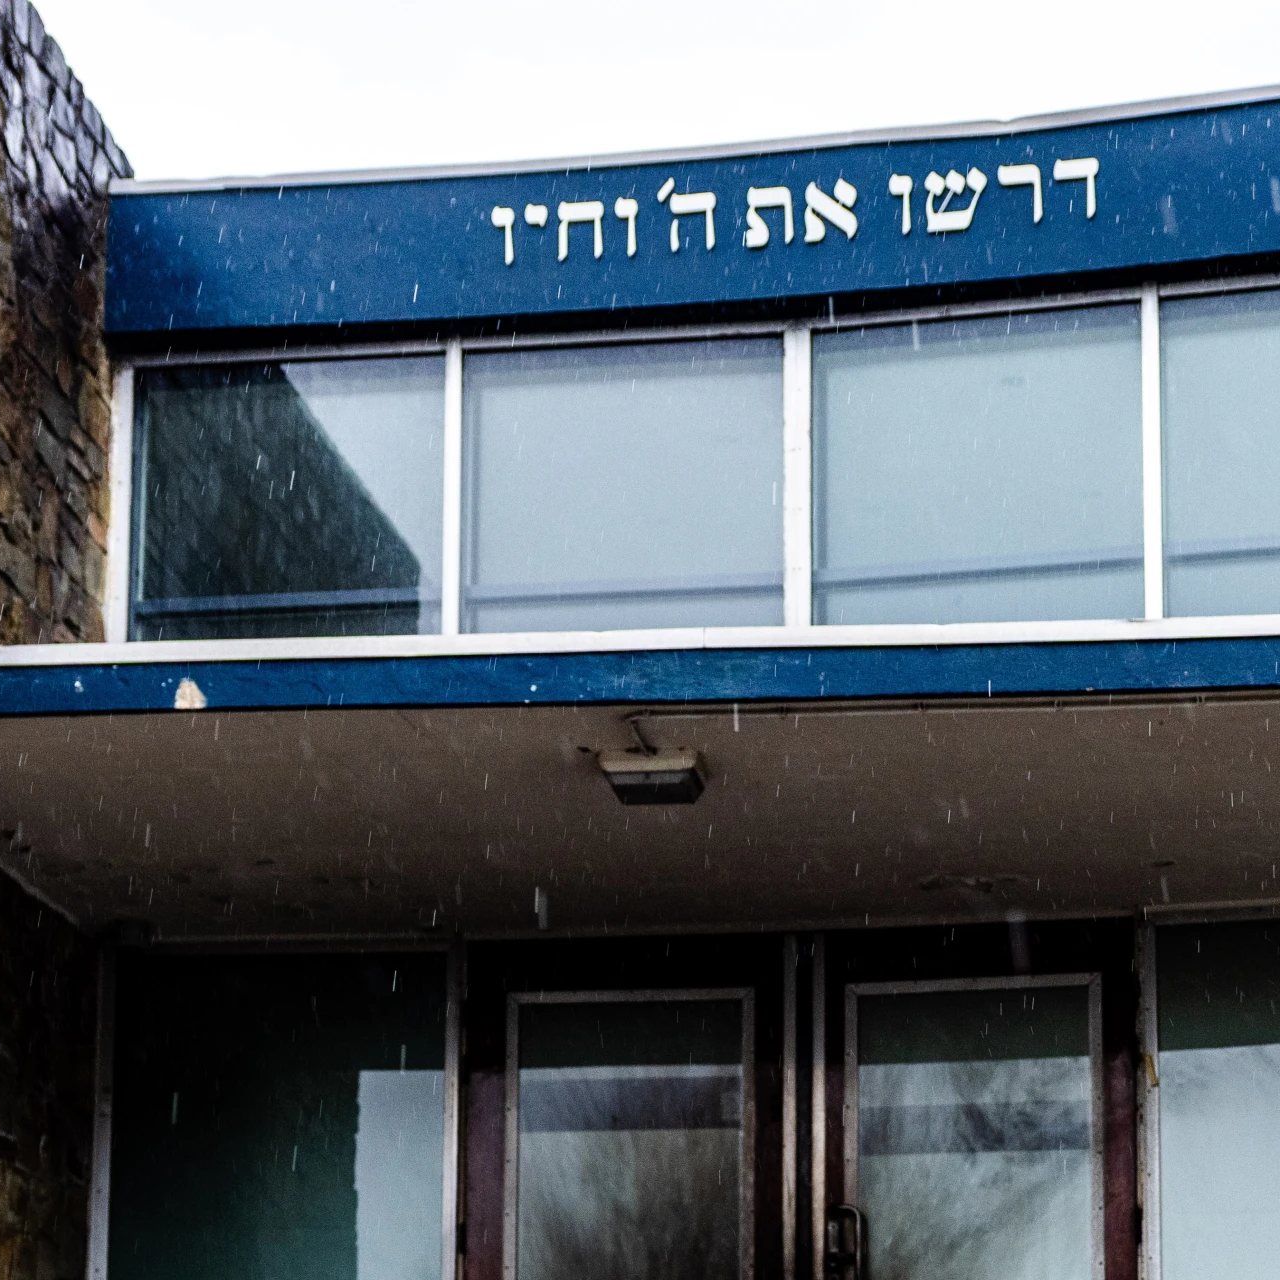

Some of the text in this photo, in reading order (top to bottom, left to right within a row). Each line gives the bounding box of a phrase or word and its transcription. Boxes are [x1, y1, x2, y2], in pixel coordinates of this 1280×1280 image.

[490, 196, 640, 266] וחיו
[745, 178, 859, 249] את
[888, 157, 1099, 236] דרשו
